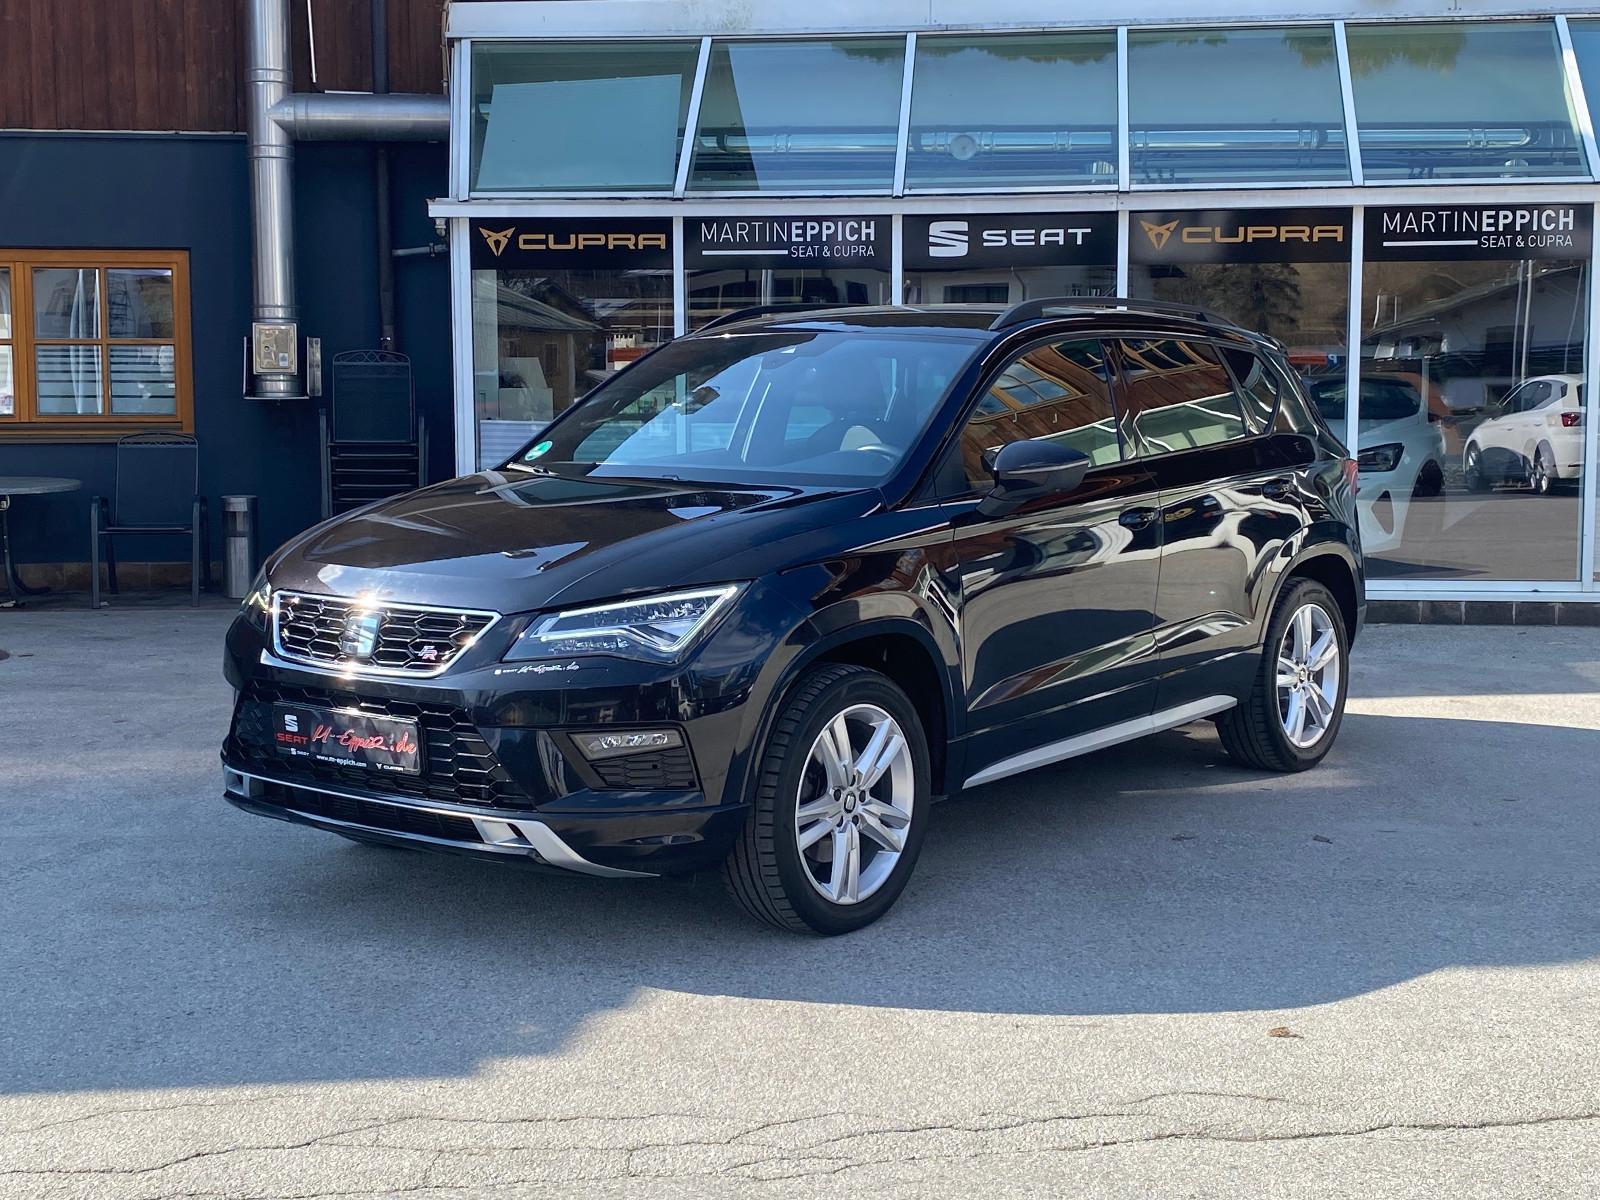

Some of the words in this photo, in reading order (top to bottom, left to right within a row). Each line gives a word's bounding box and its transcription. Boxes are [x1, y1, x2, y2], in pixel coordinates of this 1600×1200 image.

[1383, 209, 1575, 234] MARTINEPPICH
[701, 220, 876, 243] MARTINEPPICH
[982, 228, 1092, 247] SEAT
[1181, 225, 1344, 243] CUPRA
[518, 233, 666, 250] CUPRA
[1480, 235, 1513, 248] SEAT
[1515, 235, 1525, 248] &
[1528, 234, 1573, 248] CUPRA
[791, 245, 820, 258] SEAT
[822, 245, 831, 257] &
[833, 245, 875, 257] CUPRA
[276, 732, 309, 745] SEAT
